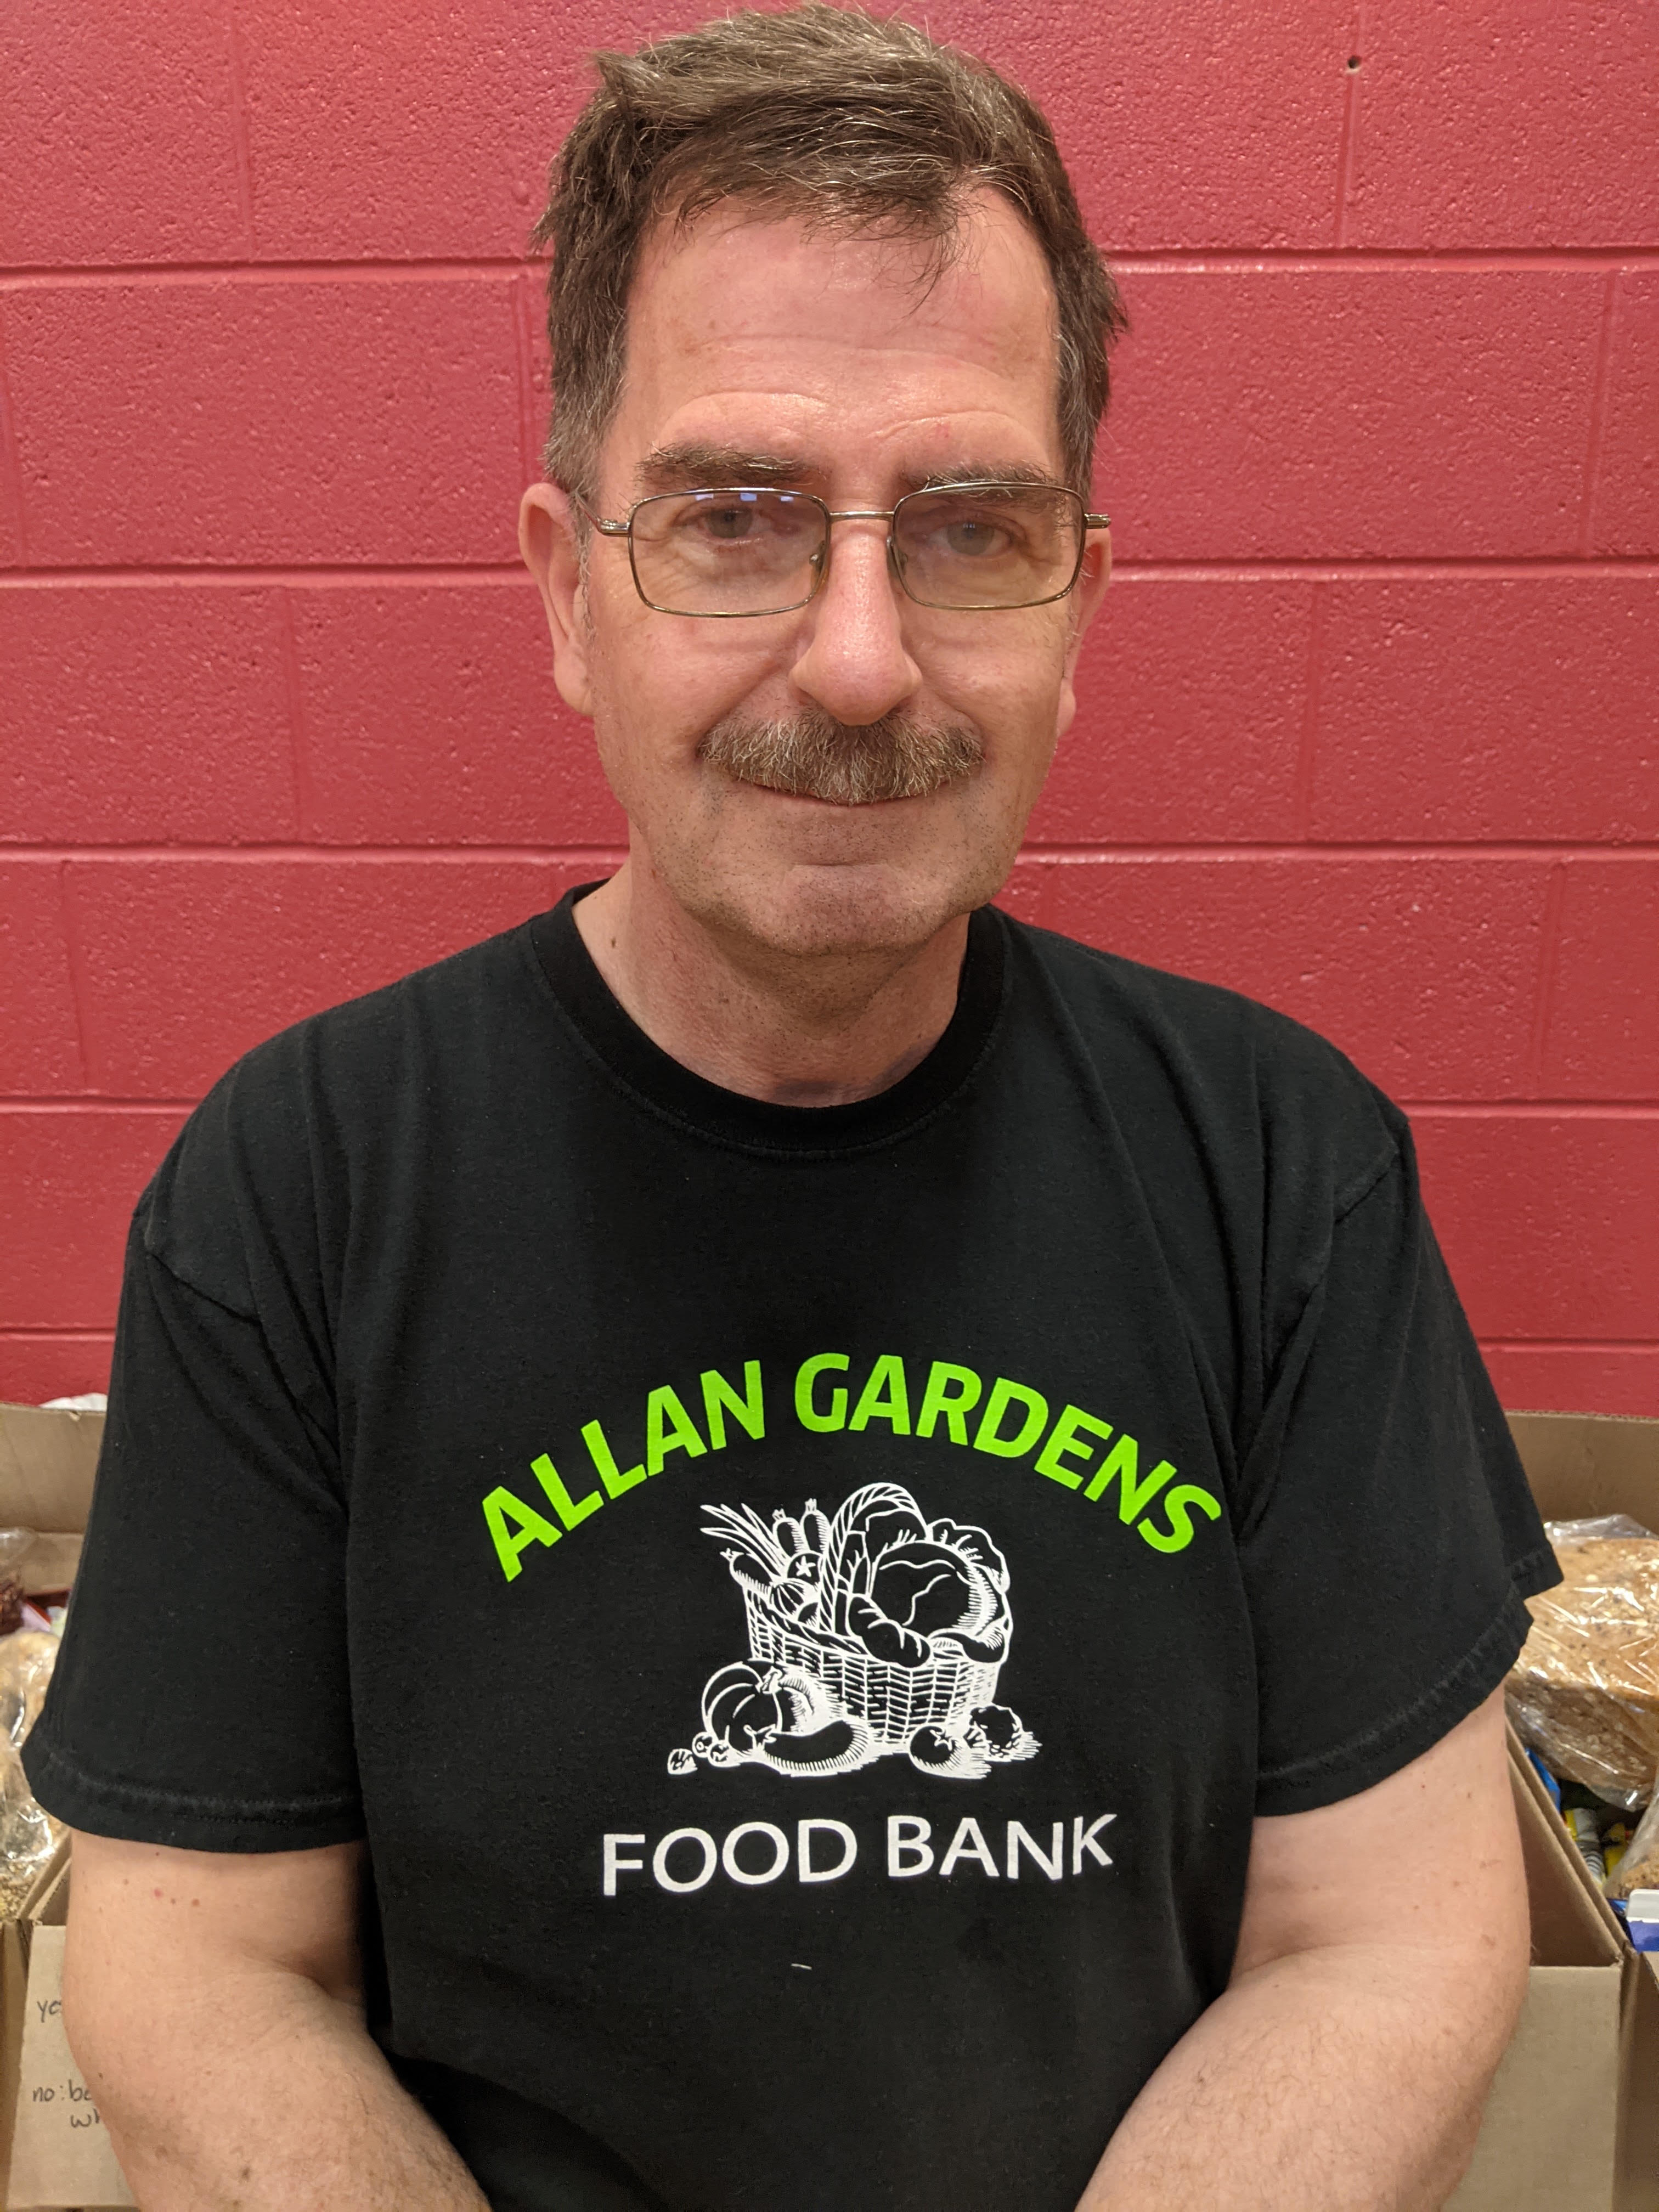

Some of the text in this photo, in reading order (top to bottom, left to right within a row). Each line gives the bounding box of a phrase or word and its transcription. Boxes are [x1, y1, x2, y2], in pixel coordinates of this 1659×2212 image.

[482, 1352, 1222, 1582] ALLAN GARDENS
[602, 1813, 1118, 1897] FOOD BANK
